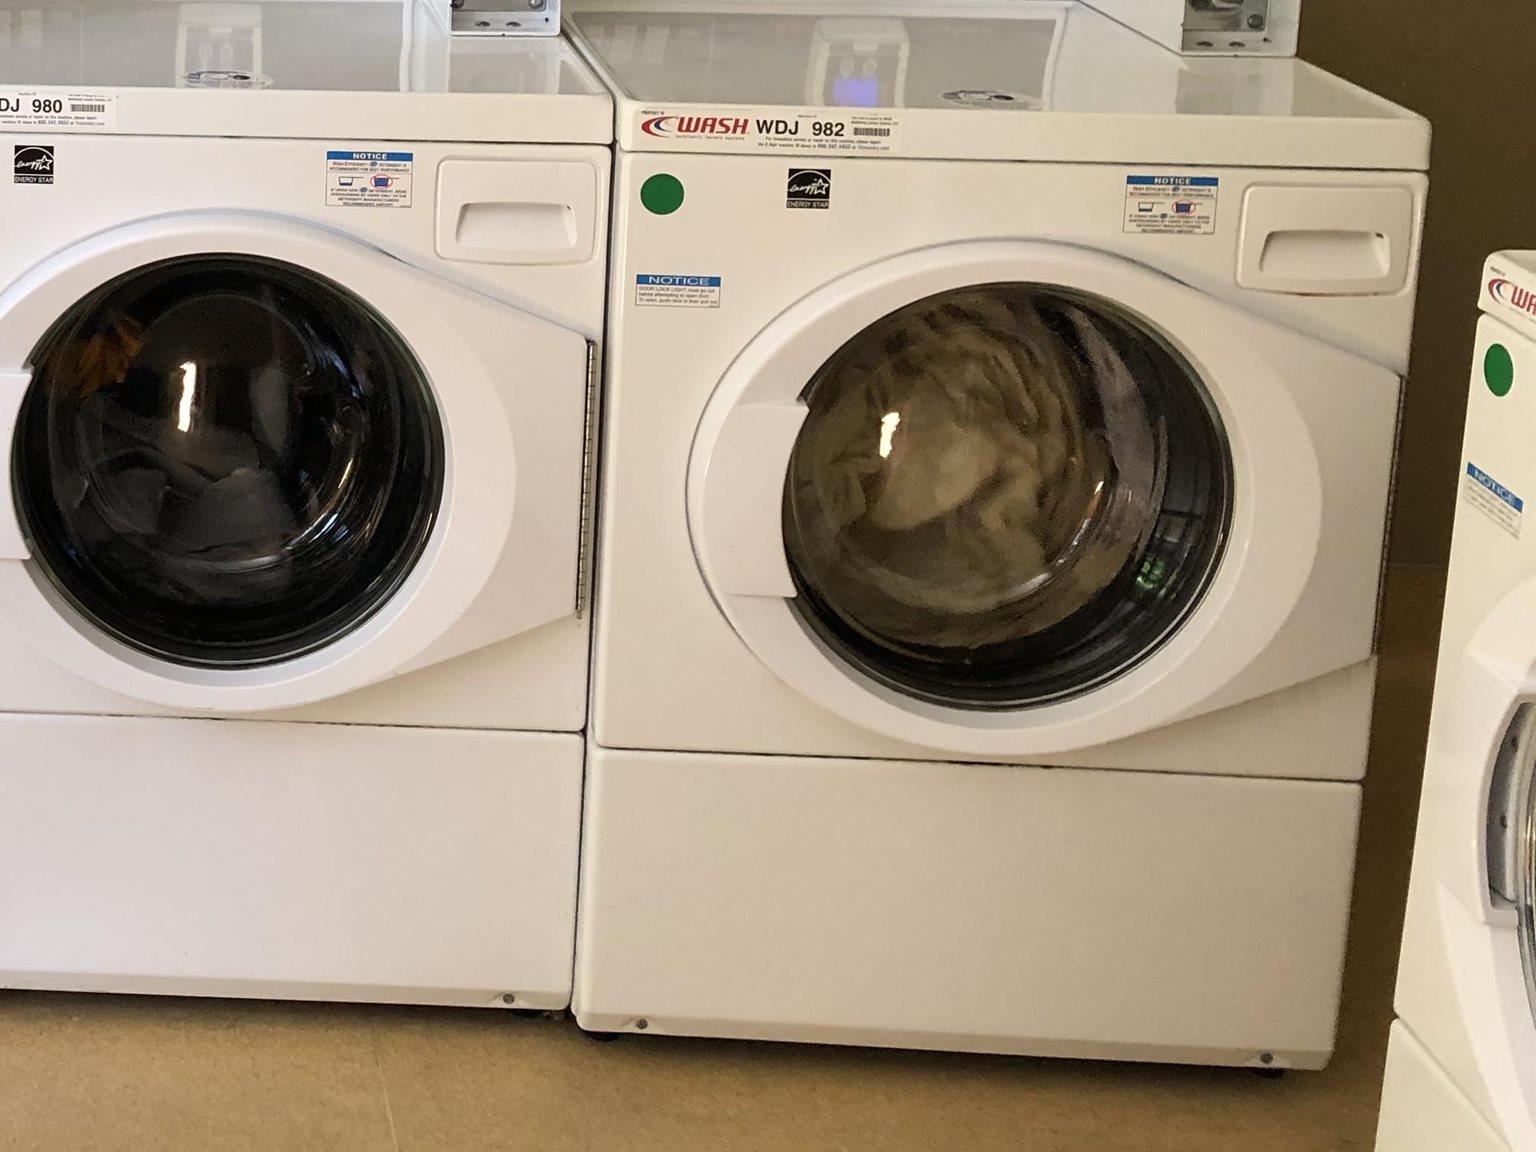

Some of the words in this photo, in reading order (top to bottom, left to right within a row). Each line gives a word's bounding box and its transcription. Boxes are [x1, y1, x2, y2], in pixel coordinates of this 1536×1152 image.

[32, 99, 63, 113] 980
[677, 117, 750, 135] WASH
[756, 119, 799, 136] WDJ
[811, 122, 845, 137] 982
[37, 176, 54, 184] STAR
[1154, 177, 1192, 185] NOTICE
[786, 200, 811, 208] ENERGY
[811, 201, 829, 209] STAR
[648, 276, 710, 286] NOTICE
[1511, 286, 1536, 315] WA
[1474, 468, 1516, 506] NOTICE
